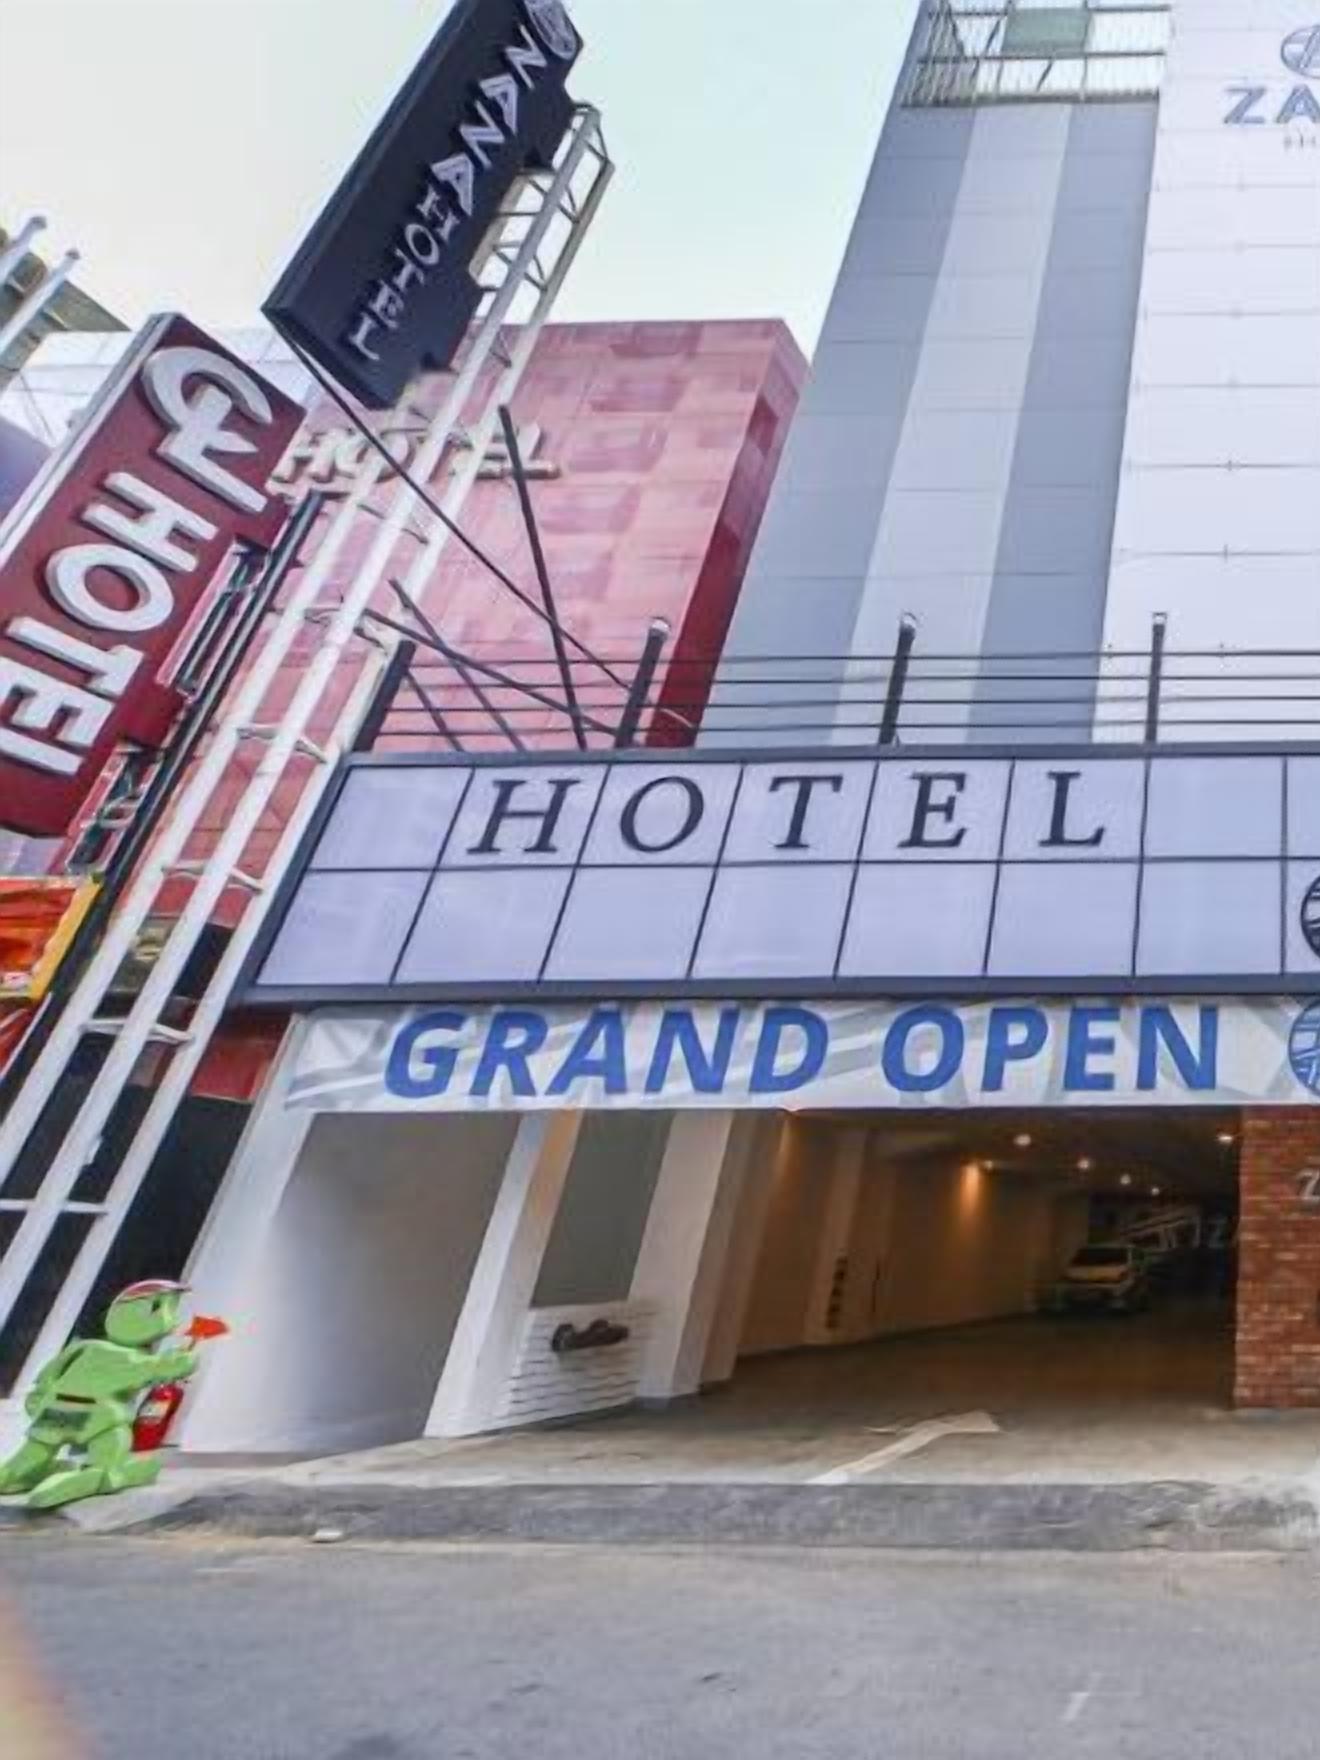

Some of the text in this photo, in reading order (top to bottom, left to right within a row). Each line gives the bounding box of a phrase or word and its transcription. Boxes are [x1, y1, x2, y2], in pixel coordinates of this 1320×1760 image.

[270, 422, 562, 485] HOEL
[466, 771, 1106, 855] HOTEL
[384, 1002, 830, 1099] GRAND
[880, 1002, 1220, 1094] OPEN
